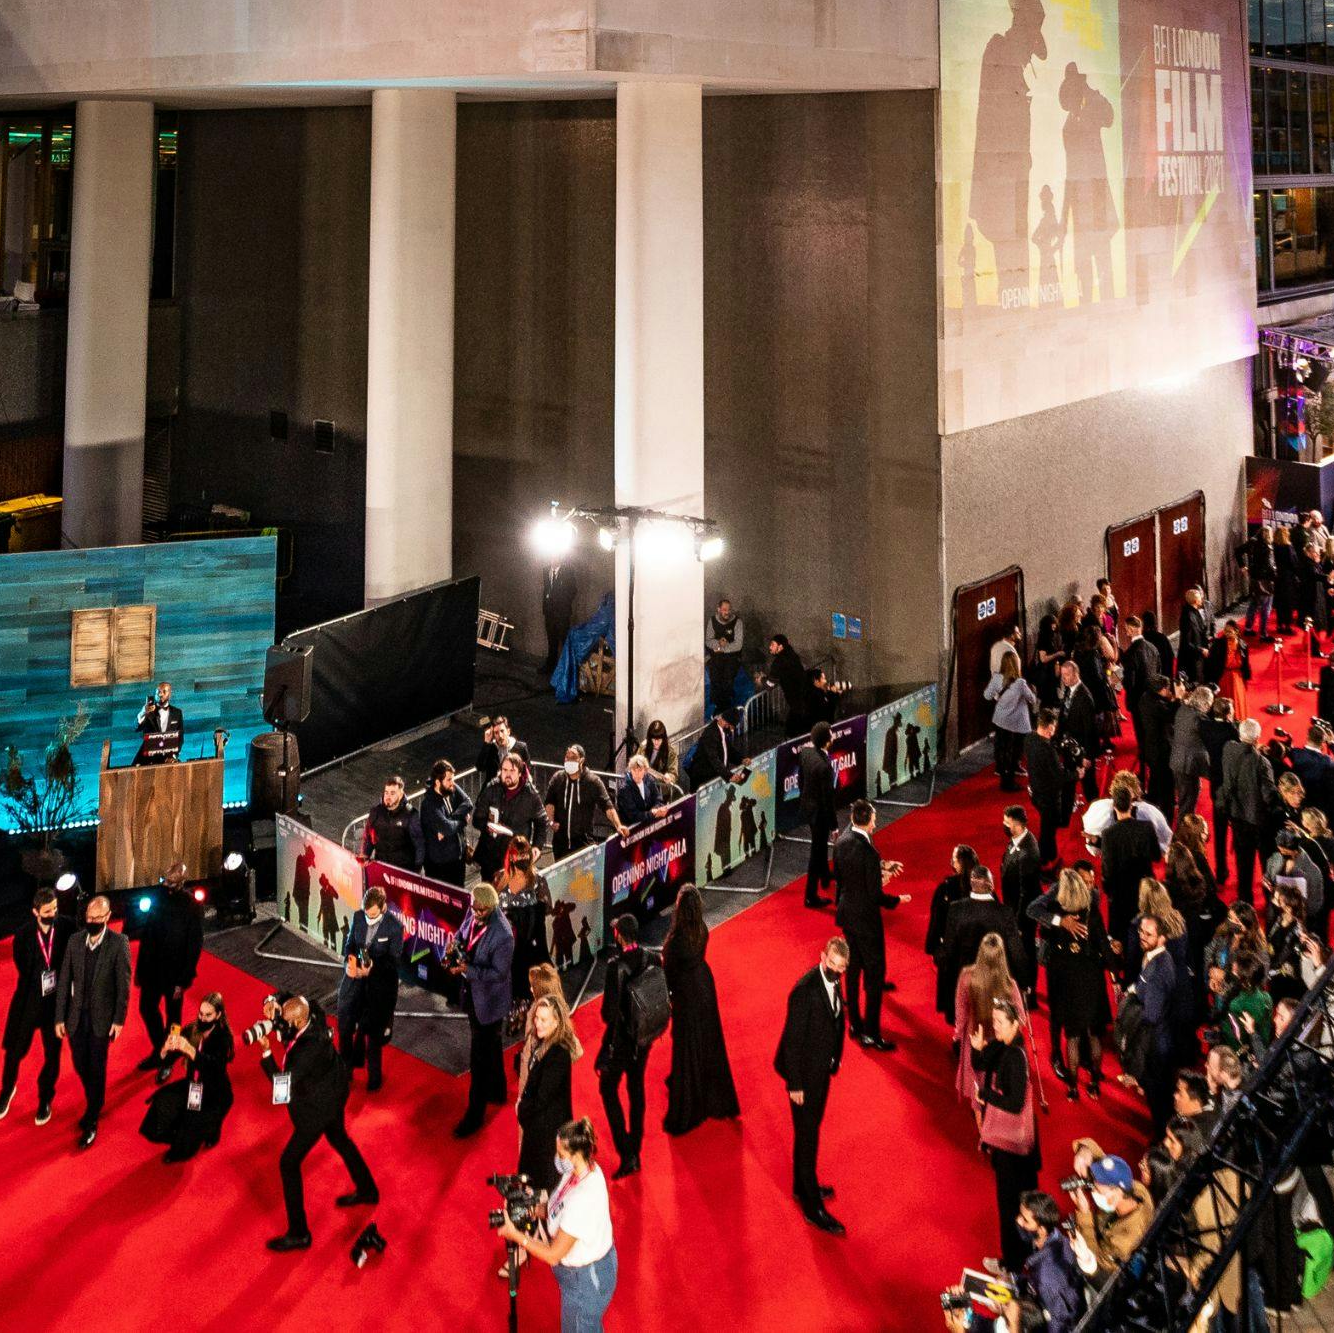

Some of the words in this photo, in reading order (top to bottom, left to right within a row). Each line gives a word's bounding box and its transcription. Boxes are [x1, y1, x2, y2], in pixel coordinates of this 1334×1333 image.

[1153, 24, 1170, 65] BFI
[1173, 27, 1221, 71] LONDON
[1155, 69, 1224, 152] FILM
[1157, 154, 1203, 197] FESTIVAL
[838, 751, 857, 772] GALA
[611, 860, 645, 894] OPENING
[645, 848, 668, 875] NIGHT
[668, 838, 687, 862] GALA
[412, 883, 426, 896] FILM
[417, 920, 445, 947] NIGHT
